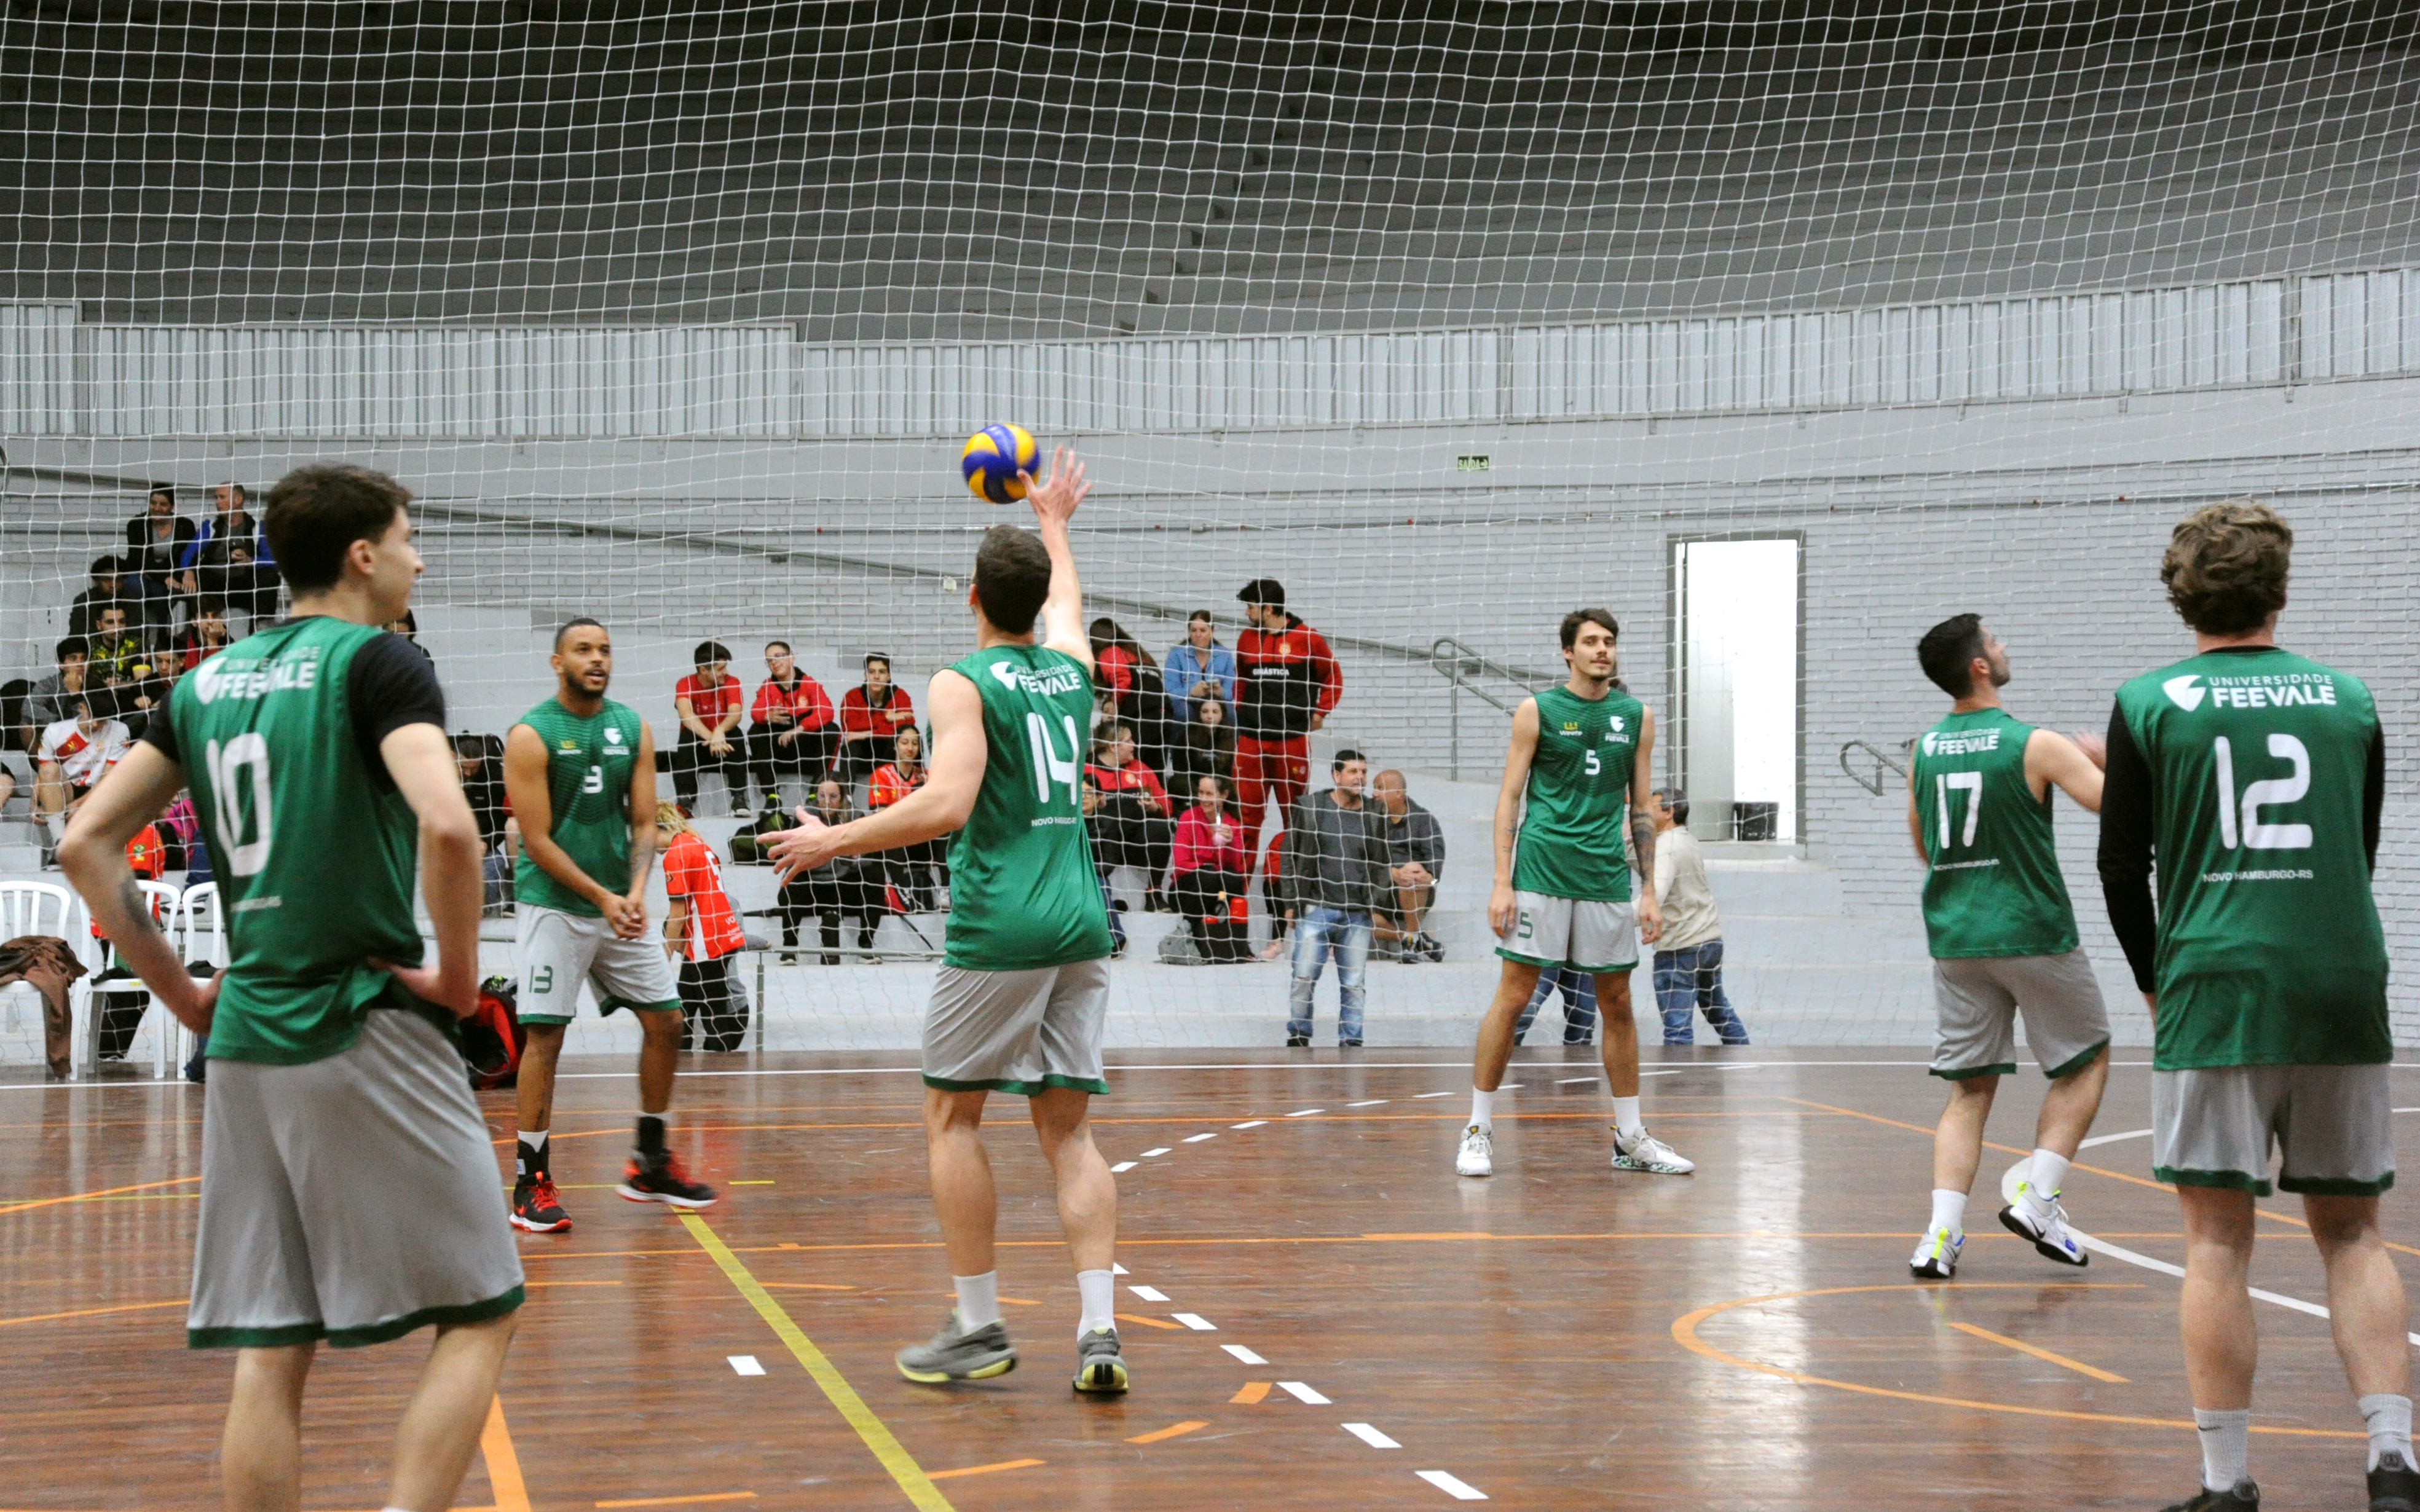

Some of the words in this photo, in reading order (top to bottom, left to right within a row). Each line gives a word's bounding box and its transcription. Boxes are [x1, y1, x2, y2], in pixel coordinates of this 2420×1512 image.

[1018, 672, 1081, 696] FEVALE
[2209, 674, 2333, 686] UNIVERSIDADE
[2212, 684, 2336, 708] FEEVALE
[1027, 712, 1079, 805] 14
[1585, 749, 1601, 775] 5
[2215, 733, 2313, 849] 12
[206, 732, 272, 877] 10
[1937, 771, 1983, 849] 17
[1031, 816, 1054, 827] NOVO
[2203, 872, 2233, 883] NOVO
[2234, 869, 2314, 881] HAMBURGO-RS
[1518, 912, 1534, 939] 5
[529, 965, 553, 993] 13
